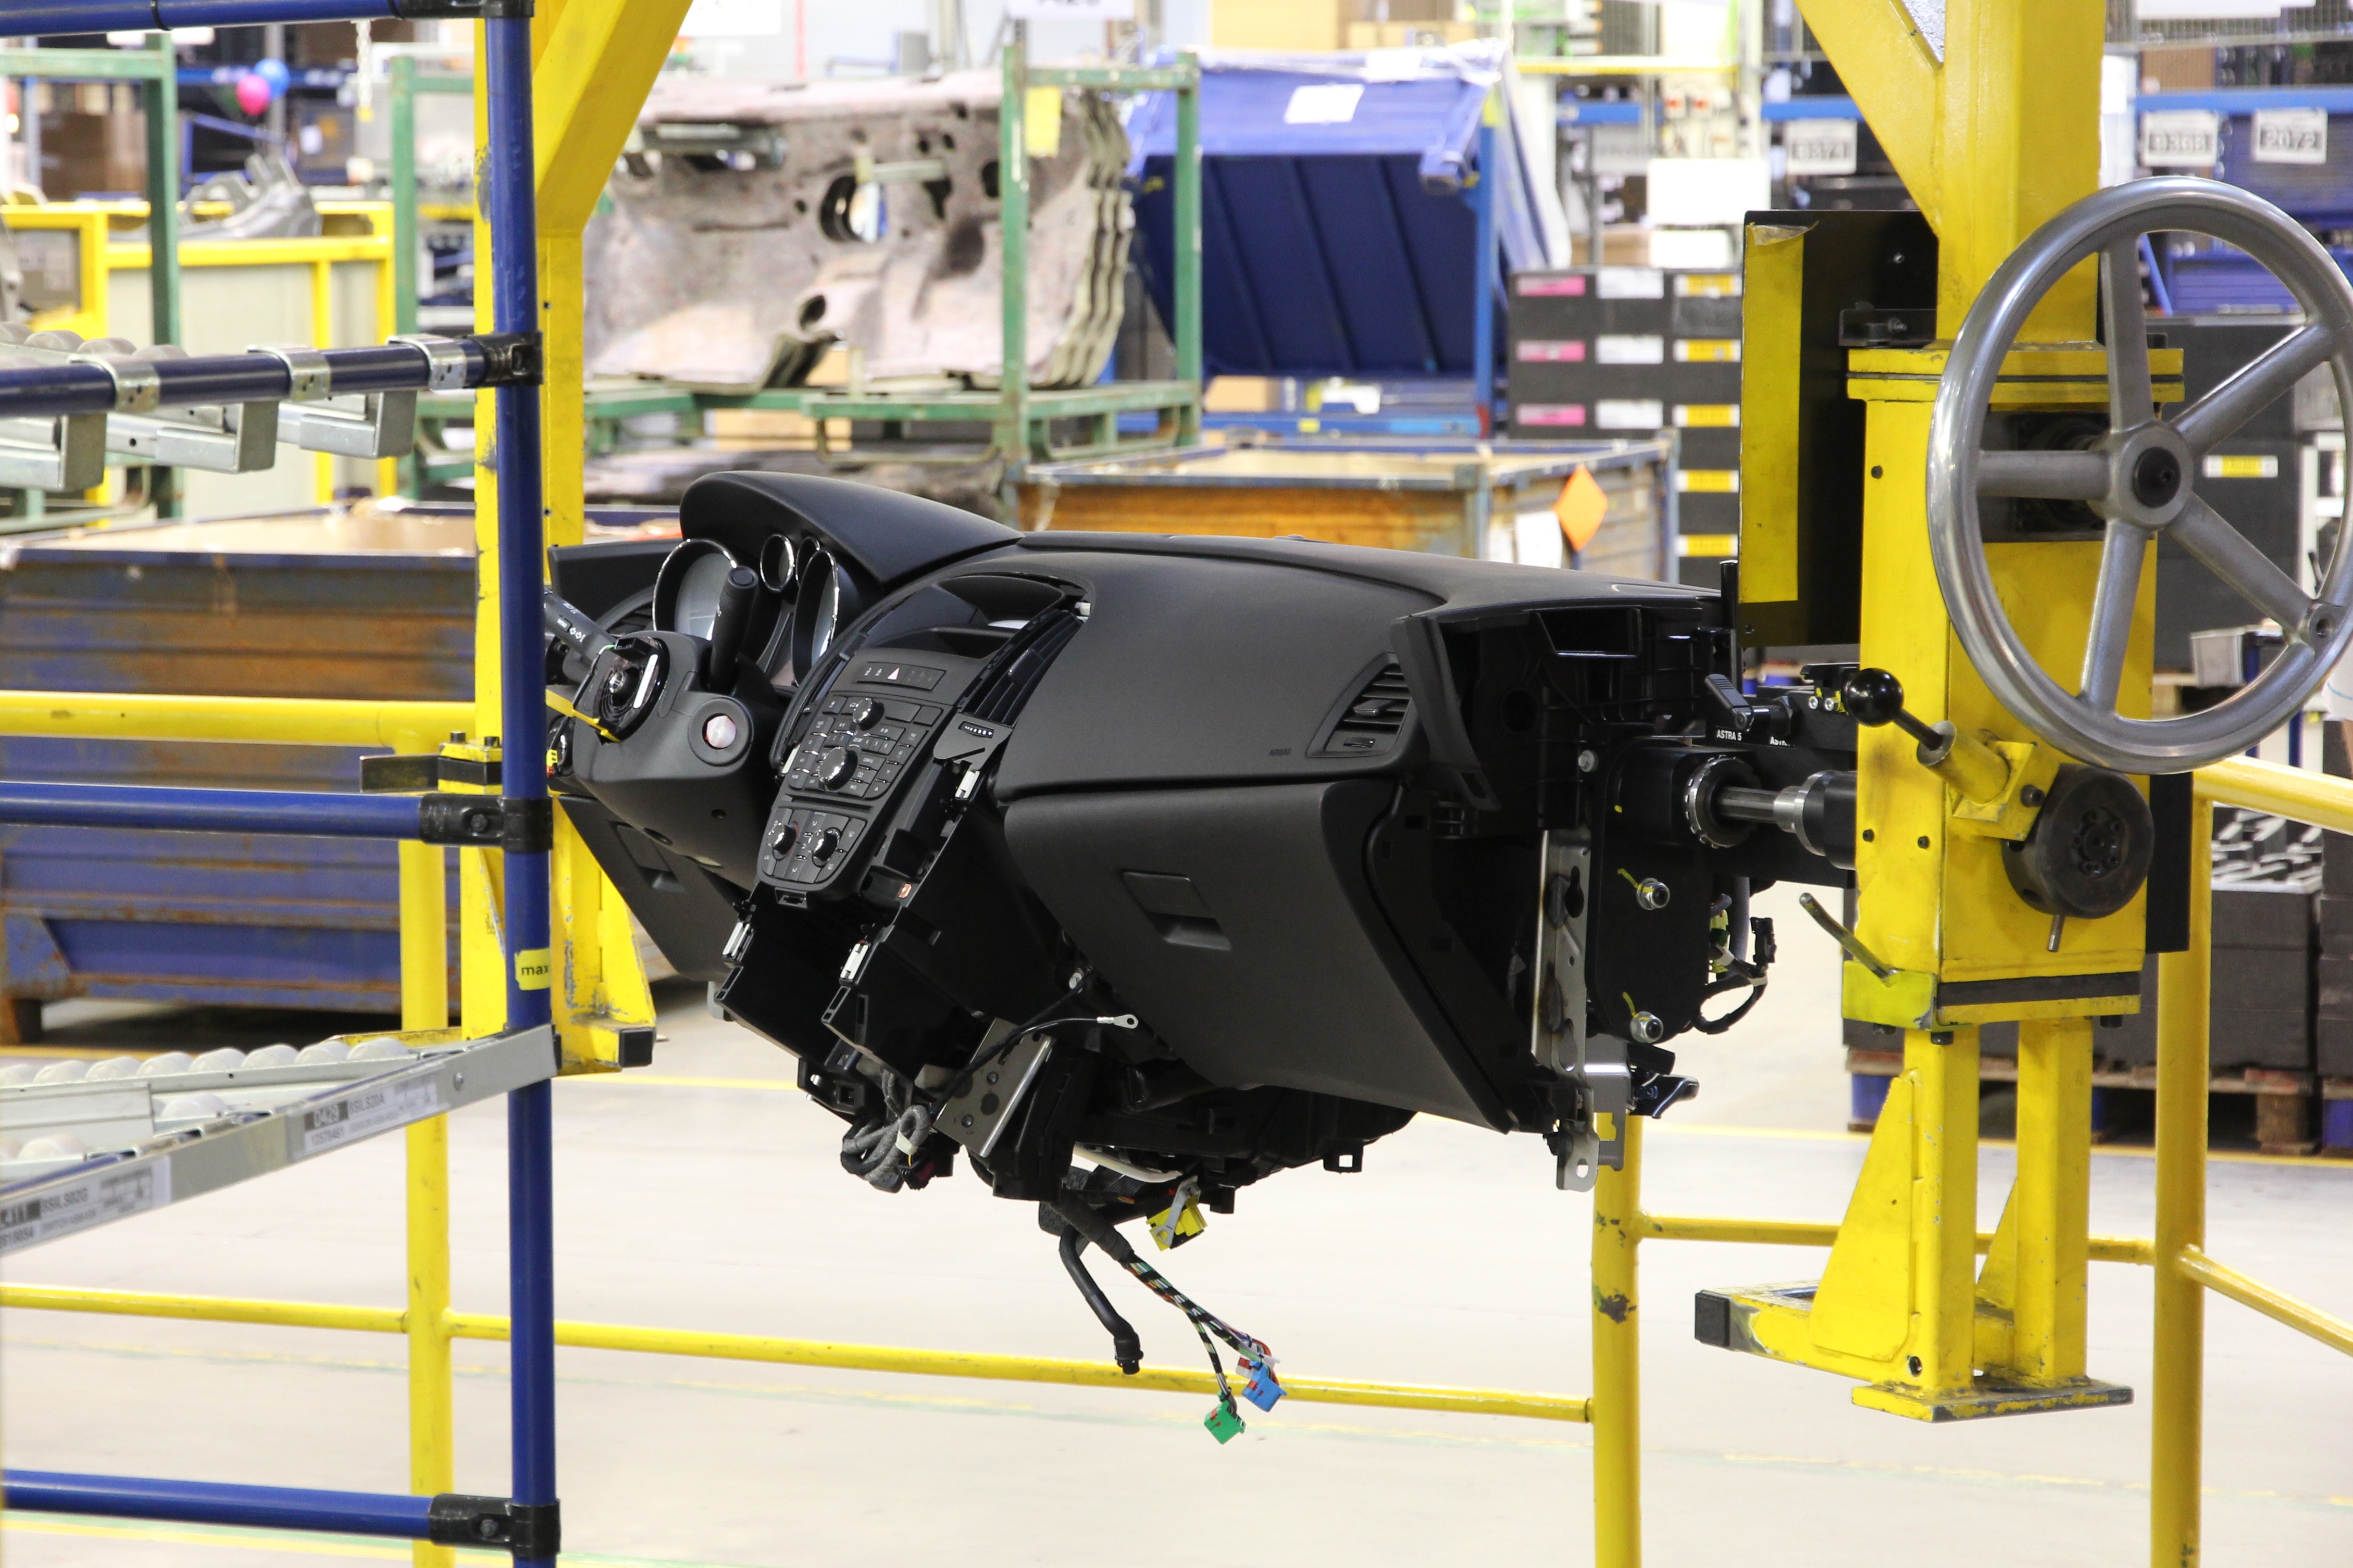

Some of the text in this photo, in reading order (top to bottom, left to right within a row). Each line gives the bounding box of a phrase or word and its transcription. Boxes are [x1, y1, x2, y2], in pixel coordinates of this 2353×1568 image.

[1716, 730, 1742, 741] ASTRA 5
[521, 965, 549, 975] max
